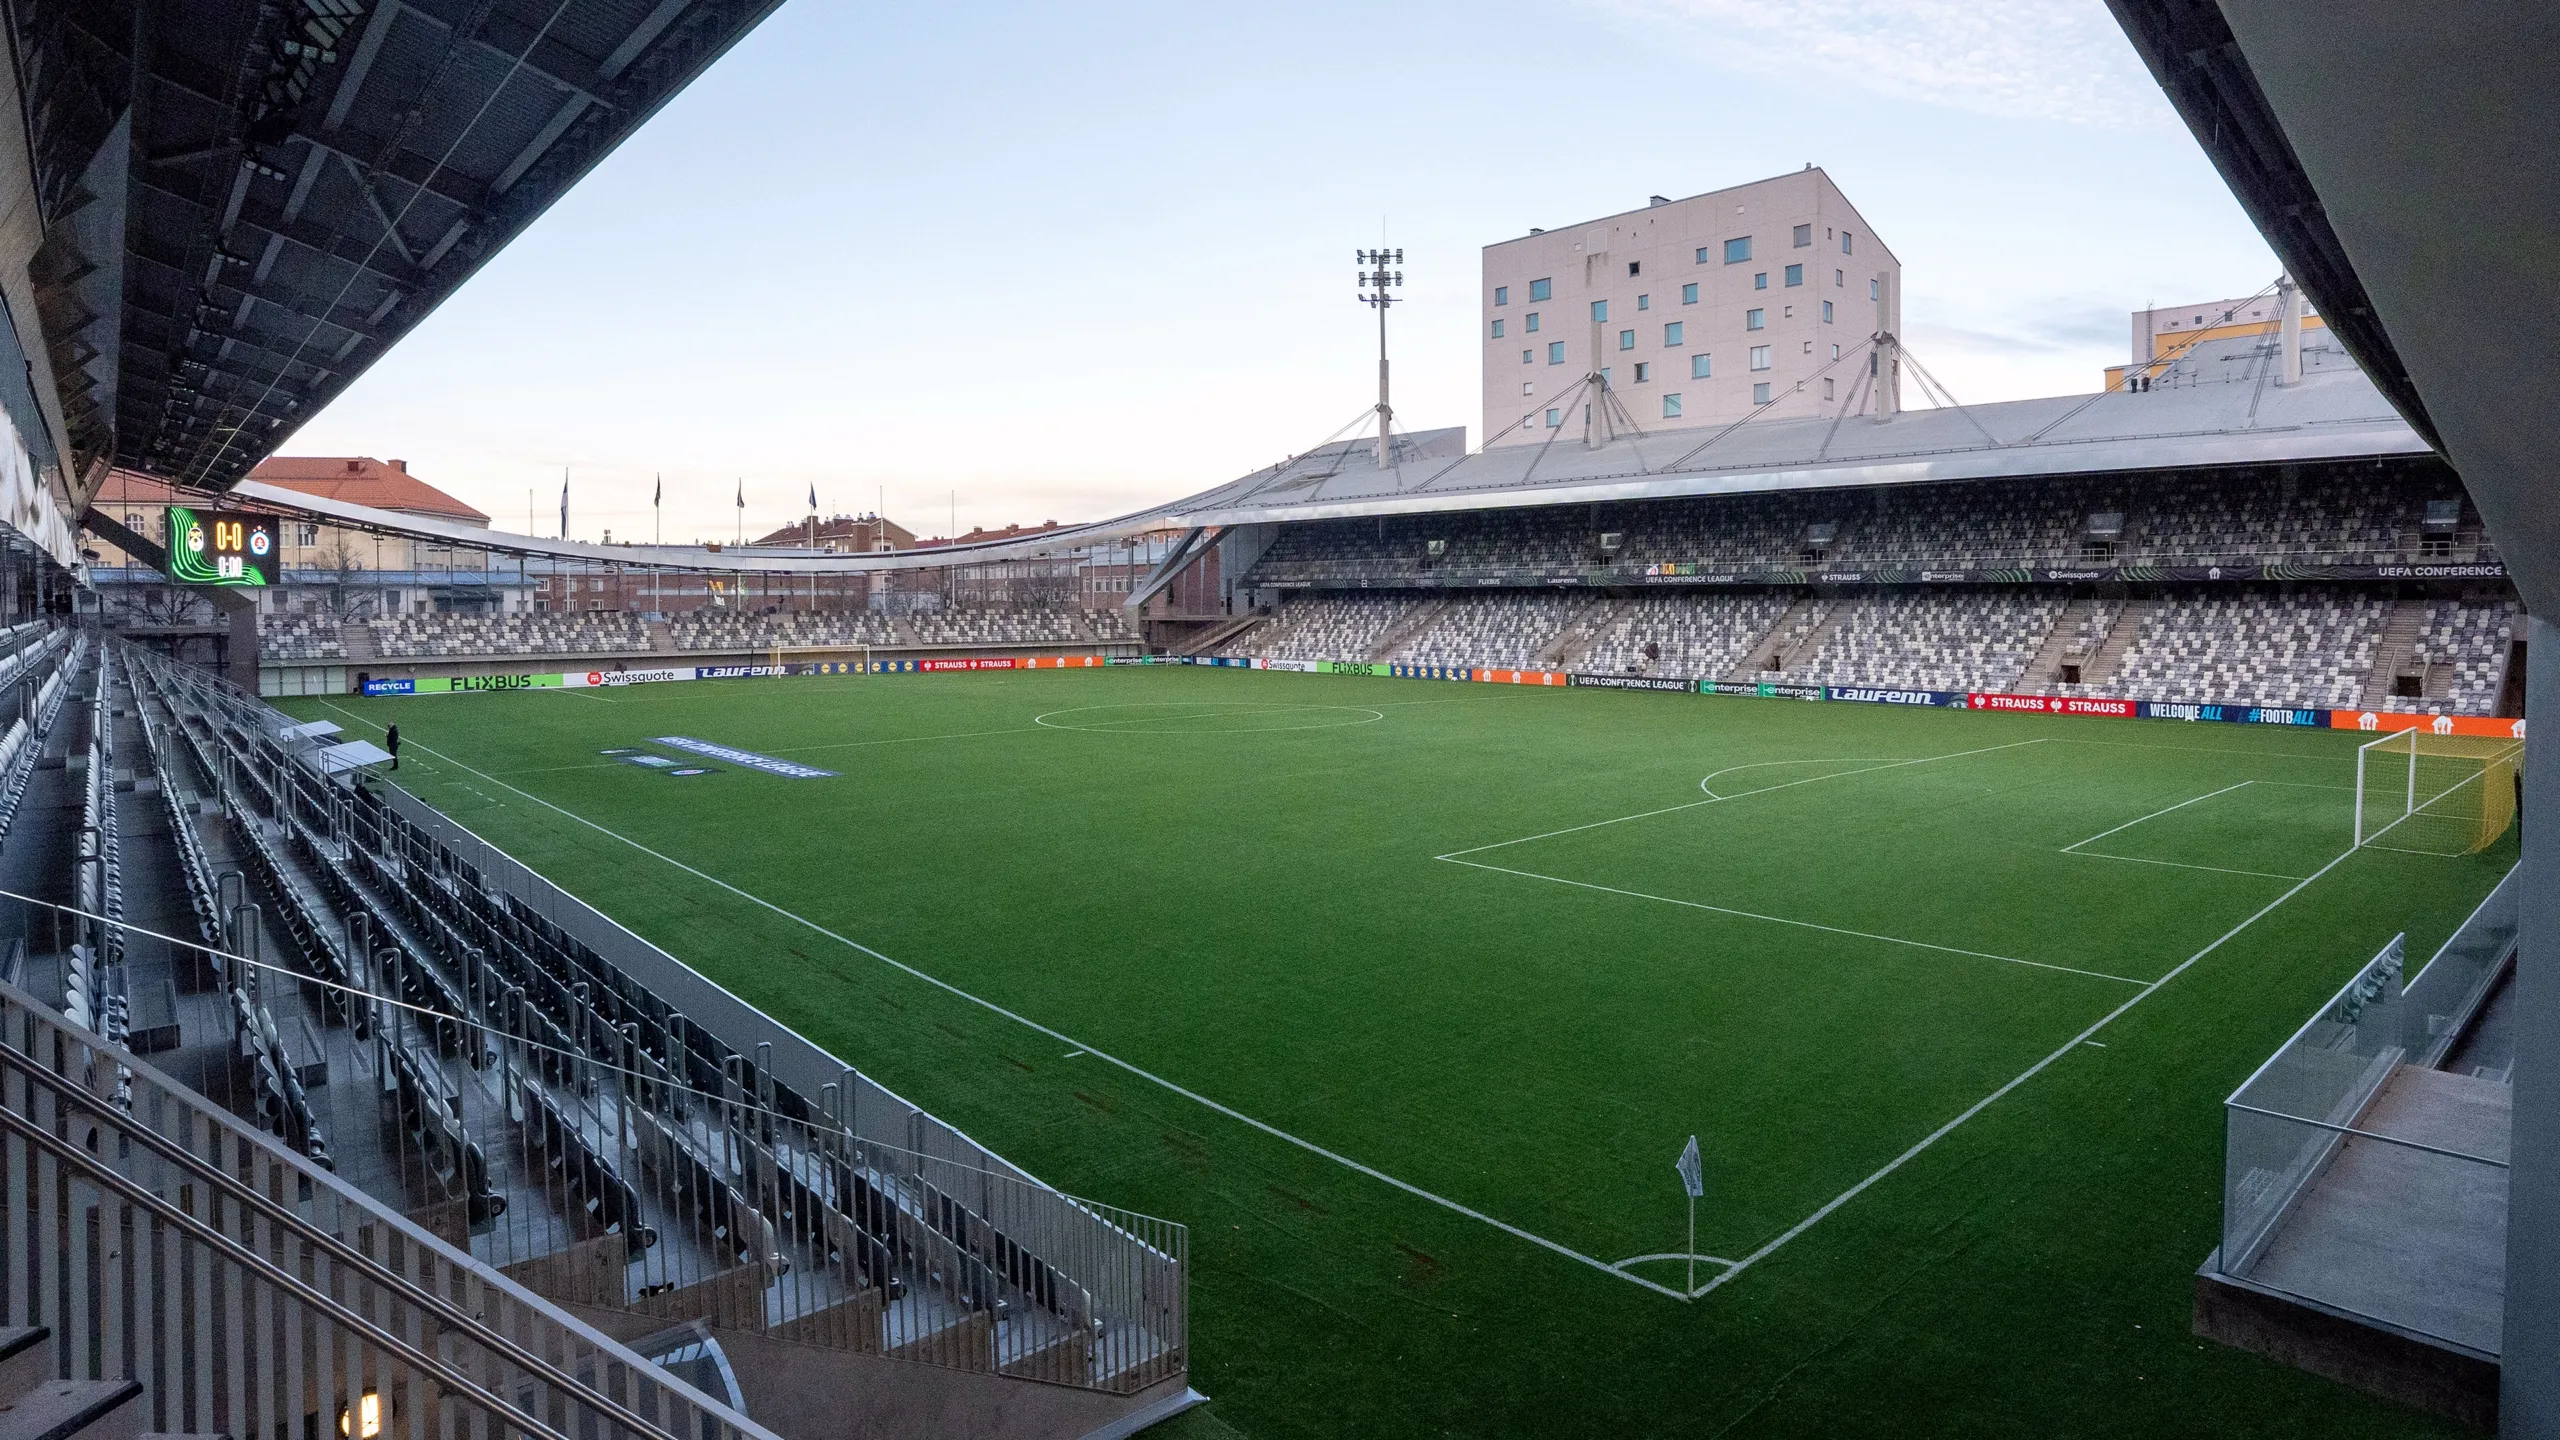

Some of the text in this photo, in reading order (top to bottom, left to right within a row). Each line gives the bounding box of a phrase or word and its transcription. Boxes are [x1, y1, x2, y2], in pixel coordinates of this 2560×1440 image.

[217, 522, 242, 551] 0-0
[219, 556, 242, 577] 0:00
[2378, 567, 2412, 576] UEFA
[2415, 566, 2502, 576] CONFERENCE
[1663, 575, 1706, 583] CONFERENCE
[1829, 573, 1861, 581] STRAUSS
[2058, 571, 2099, 580] Swissquote
[935, 660, 1011, 669] STRAUSS STRAUSS
[1269, 660, 1305, 671] Swissquote
[603, 670, 674, 683] Swissquote
[368, 682, 411, 691] RECYCLE
[1579, 676, 1600, 686] UEFA
[1652, 680, 1684, 690] LEAGUE
[1706, 684, 1758, 693] enterprise
[1766, 687, 1820, 697] enterprise
[1991, 697, 2126, 713] STRAUSS STRAUSS
[2150, 703, 2223, 720] WELCOME ALL
[2248, 708, 2316, 725] #FOOTBALL
